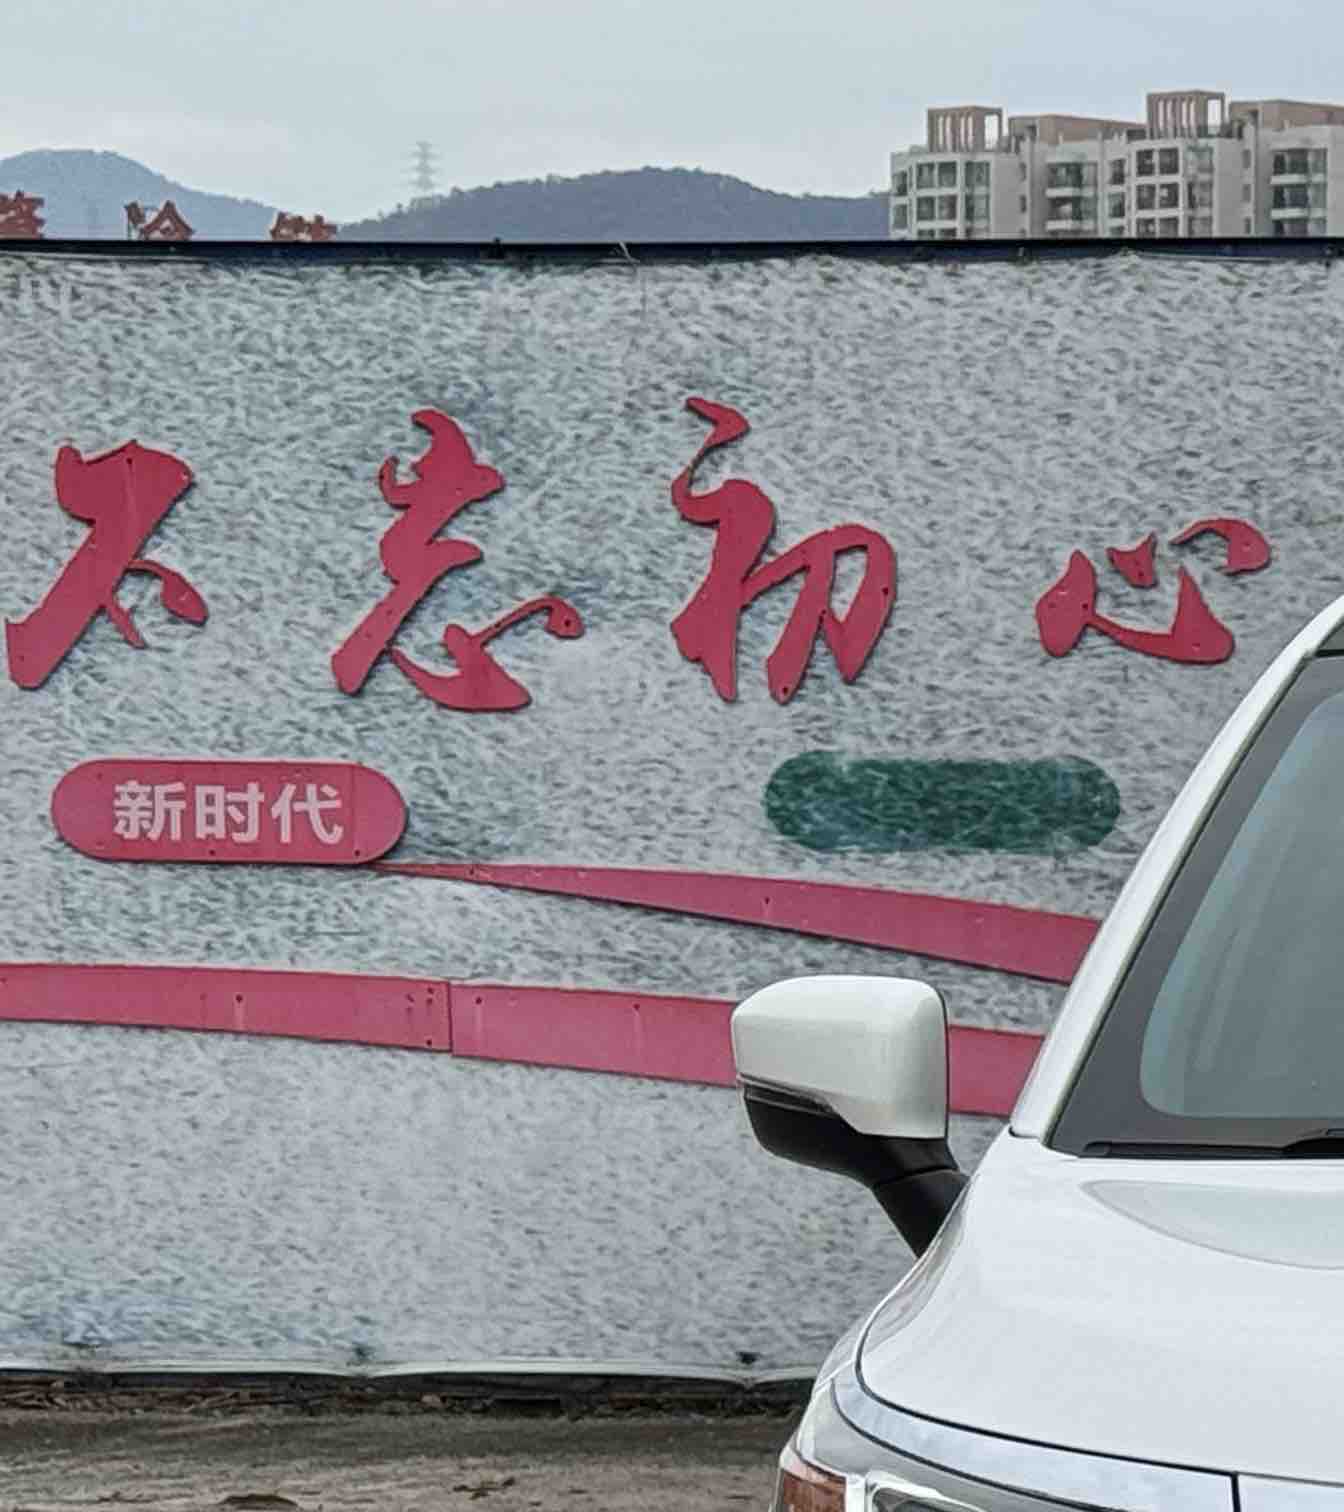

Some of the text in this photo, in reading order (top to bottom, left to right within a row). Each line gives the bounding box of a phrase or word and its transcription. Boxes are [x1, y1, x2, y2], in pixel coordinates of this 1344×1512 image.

[5, 397, 1268, 710] 不忘初心
[112, 780, 344, 844] 新时代
